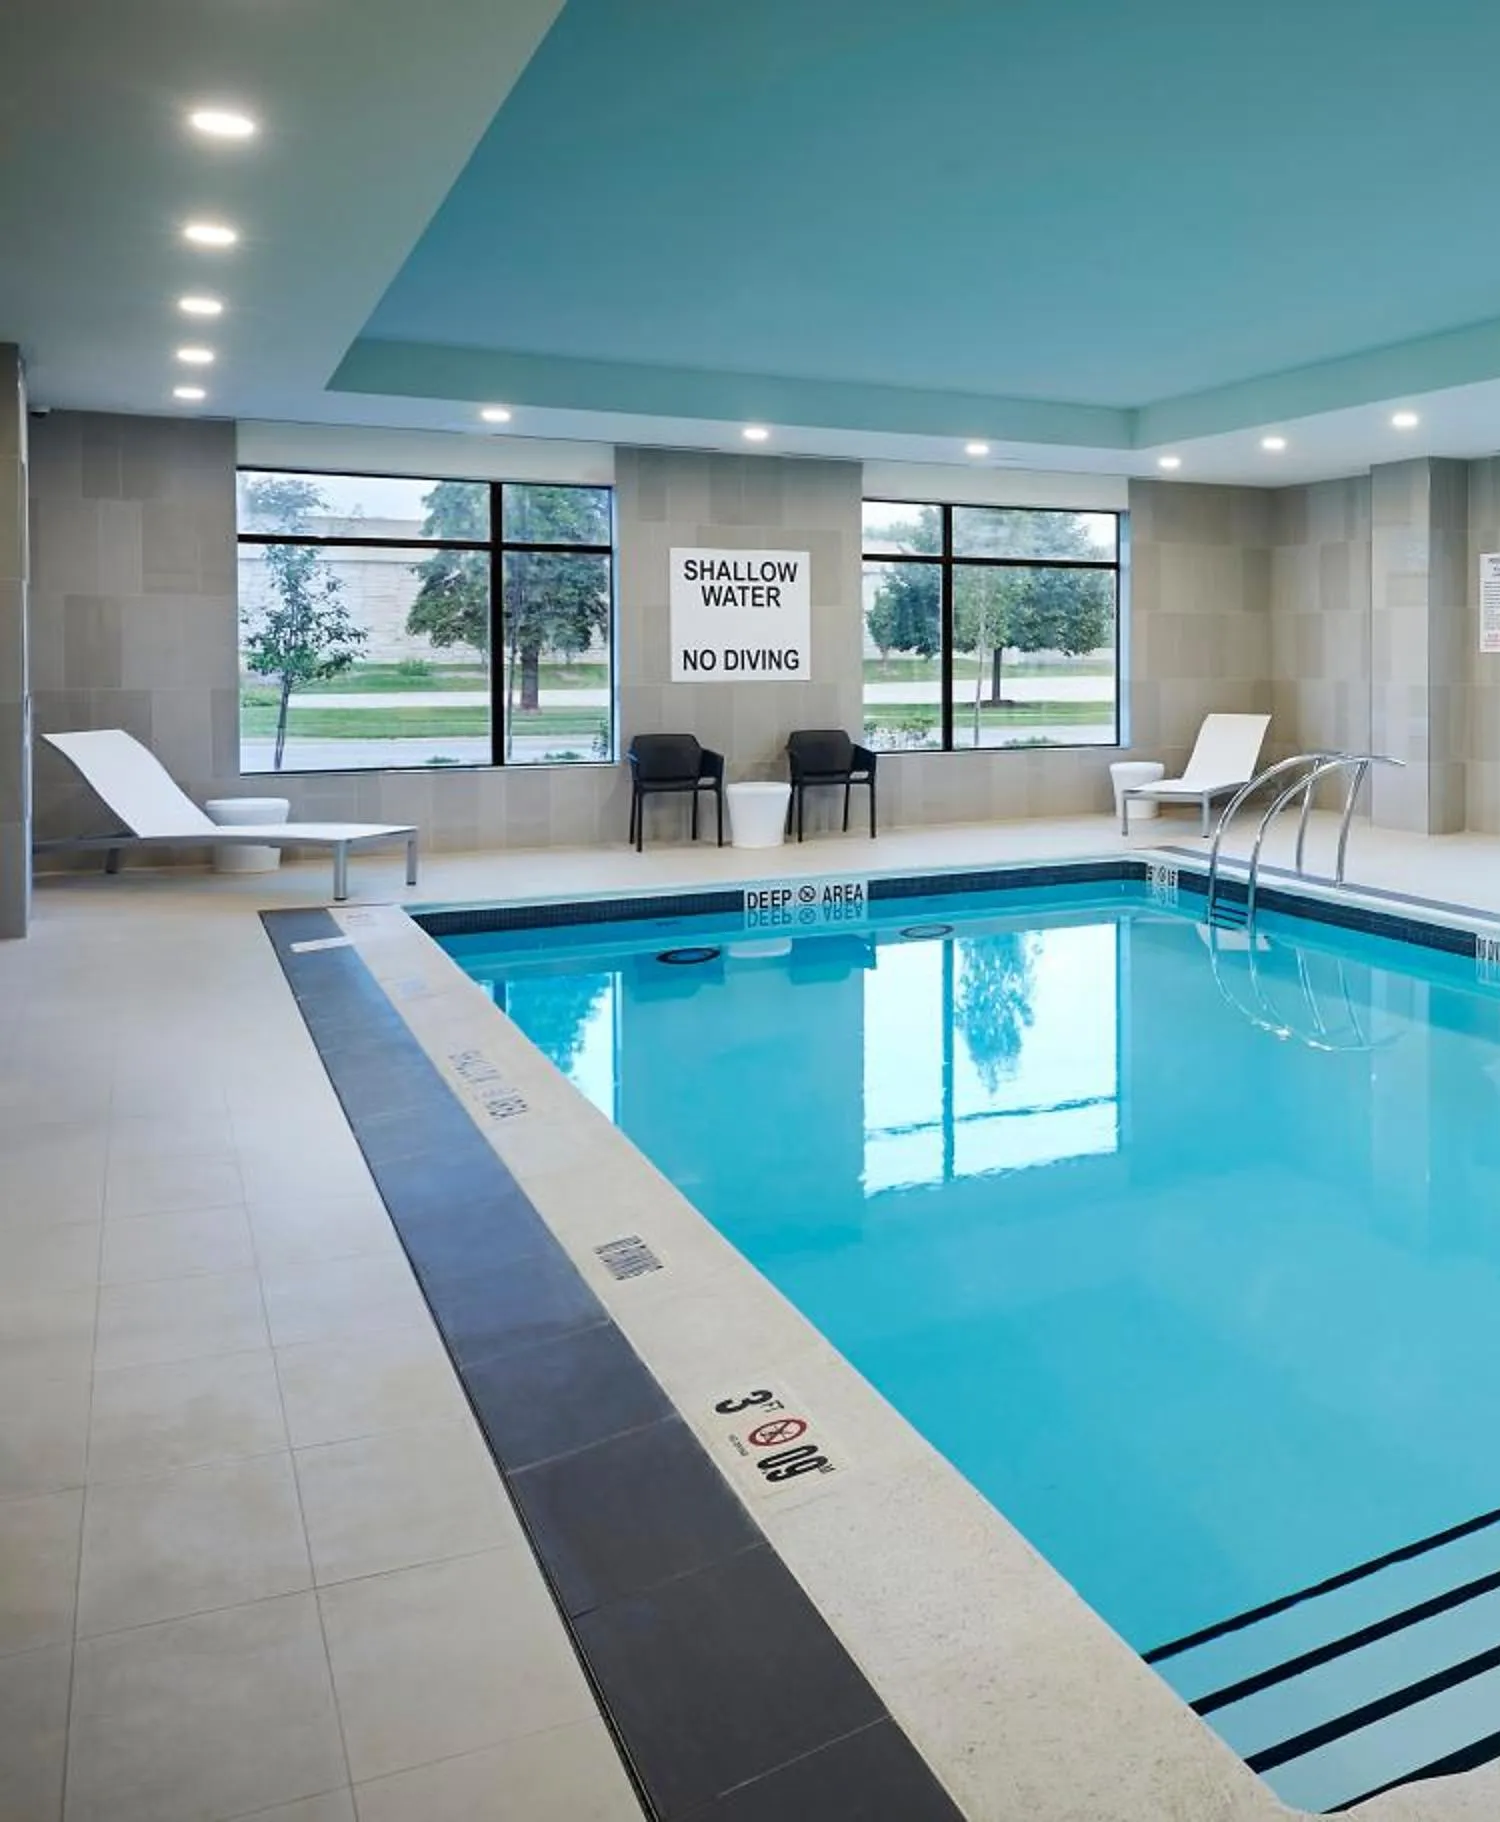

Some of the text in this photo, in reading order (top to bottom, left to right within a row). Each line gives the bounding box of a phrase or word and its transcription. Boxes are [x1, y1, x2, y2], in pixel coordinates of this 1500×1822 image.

[684, 560, 798, 582] SHALLOW
[701, 585, 782, 608] WATER
[683, 649, 799, 671] NO DIVING
[747, 883, 864, 909] DEEP AREA
